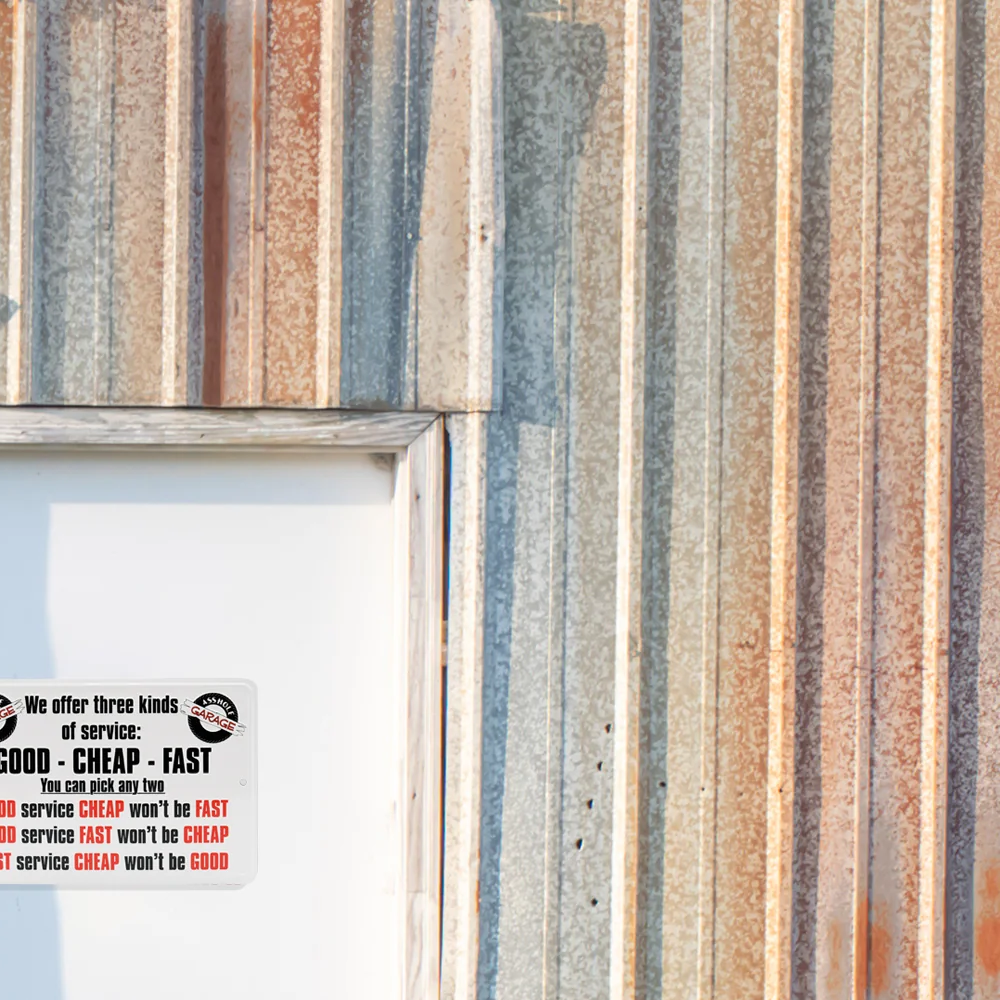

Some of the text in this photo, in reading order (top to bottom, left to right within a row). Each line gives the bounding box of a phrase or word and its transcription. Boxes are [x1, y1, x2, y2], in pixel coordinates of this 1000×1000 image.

[24, 695, 179, 714] We offer three kinds
[202, 696, 235, 716] ASSHOLE
[190, 706, 237, 731] GARAGE
[61, 721, 142, 741] of service:
[72, 747, 141, 774] CHEAP
[163, 747, 212, 774] FAST
[40, 777, 165, 795] You can pick any two
[21, 800, 74, 818] service
[79, 800, 124, 818] CHEAP
[129, 800, 169, 818] won't
[174, 800, 190, 818] be
[196, 800, 229, 818] FAST
[21, 826, 74, 844] service
[80, 826, 113, 844] FAST
[117, 826, 157, 844] won't
[162, 826, 178, 844] be
[183, 826, 229, 844] CHEAP
[17, 853, 69, 870] service
[74, 853, 119, 870] CHEAP
[125, 853, 164, 870] won't
[169, 853, 185, 870] be
[190, 853, 229, 870] GOOD
